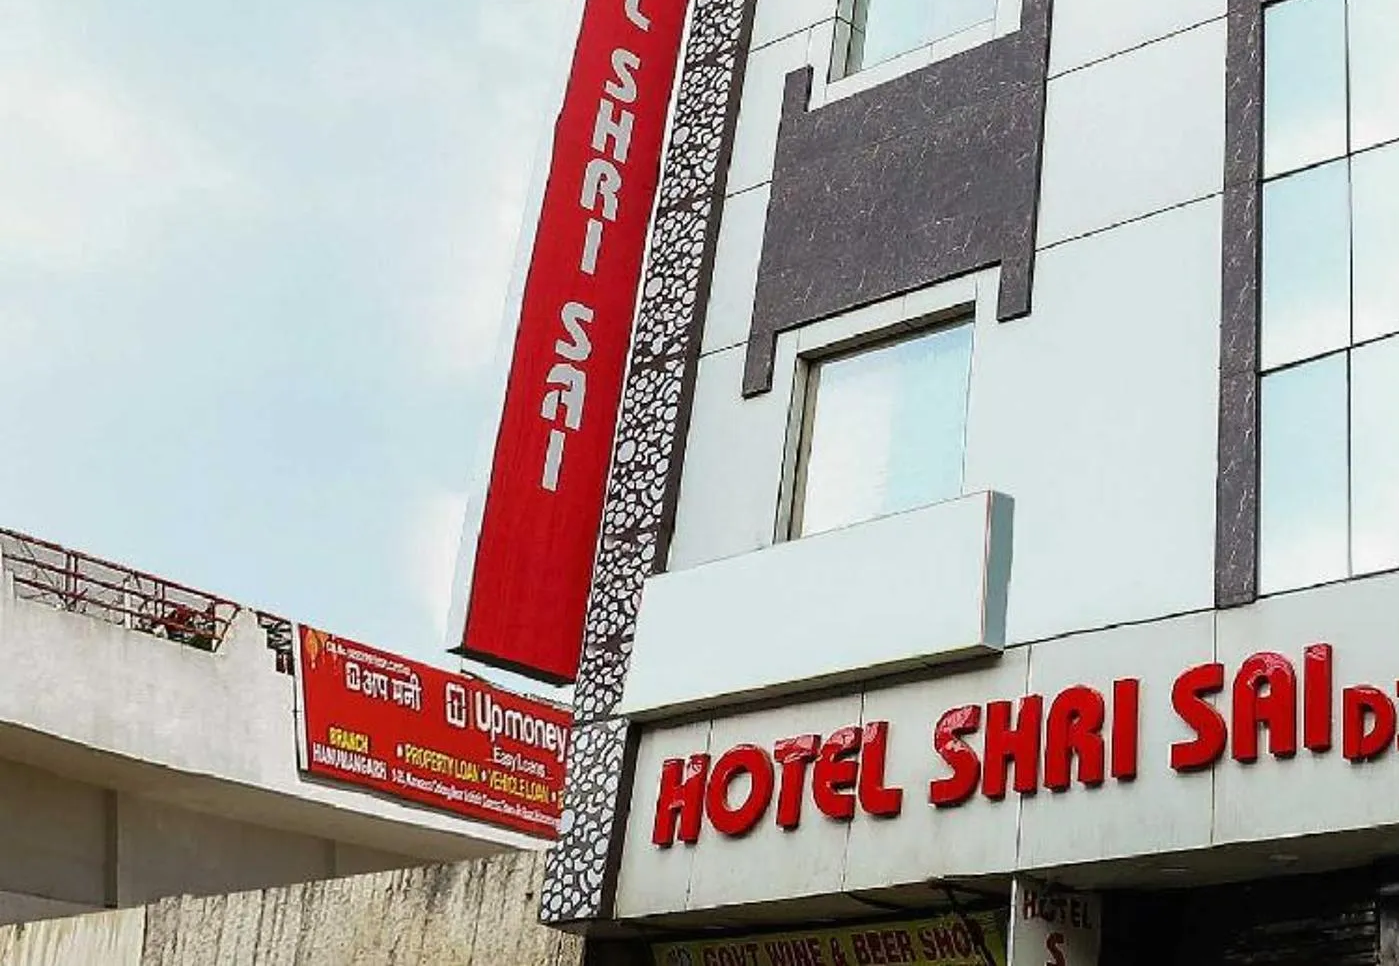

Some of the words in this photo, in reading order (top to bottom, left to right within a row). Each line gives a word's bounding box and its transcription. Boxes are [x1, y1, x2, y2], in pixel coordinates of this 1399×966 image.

[580, 49, 640, 276] SHRI
[540, 300, 593, 491] SAI
[404, 743, 453, 777] PROPERTY
[454, 755, 480, 783] LOAN
[652, 720, 902, 849] HOTEL
[929, 678, 1139, 809] SHRI
[1171, 643, 1332, 774] SAI
[851, 929, 917, 964] BEER
